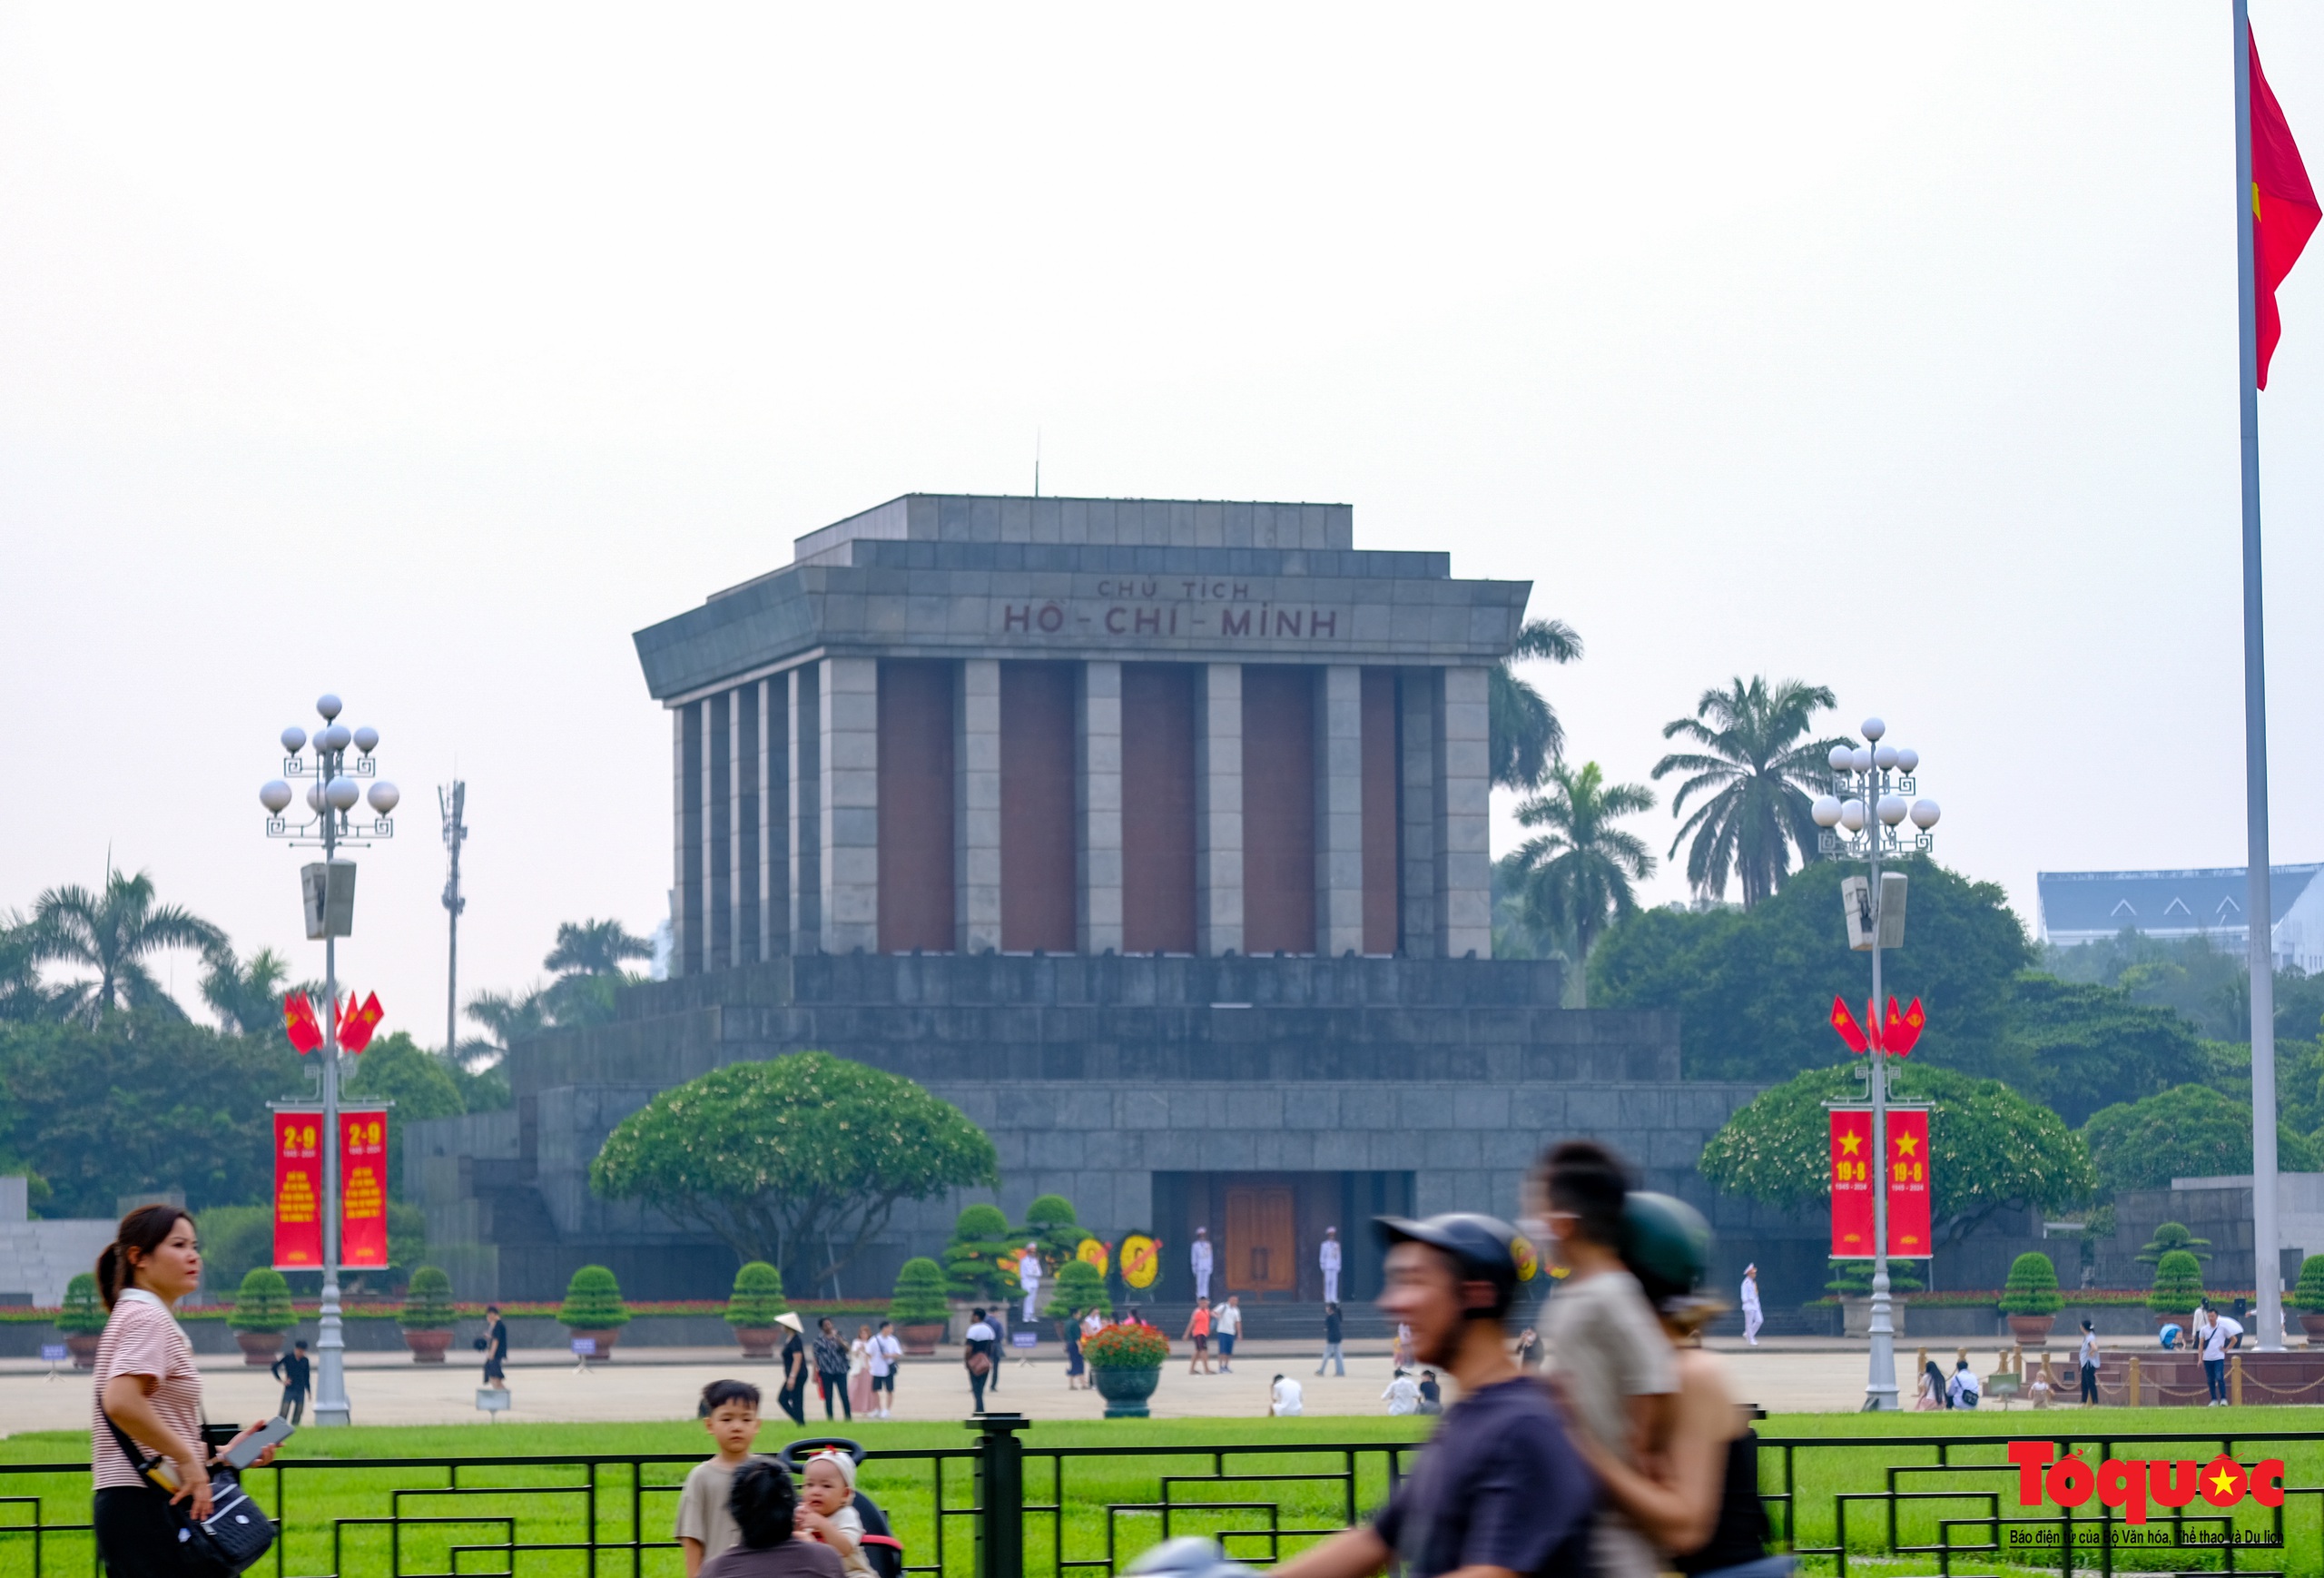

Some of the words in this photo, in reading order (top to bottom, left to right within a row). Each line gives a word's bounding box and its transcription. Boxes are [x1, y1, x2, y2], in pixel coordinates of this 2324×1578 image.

[284, 1125, 316, 1149] 2-9
[349, 1121, 380, 1146] 2-9
[1837, 1161, 1866, 1180] 19-8
[1894, 1162, 1923, 1181] 19-8
